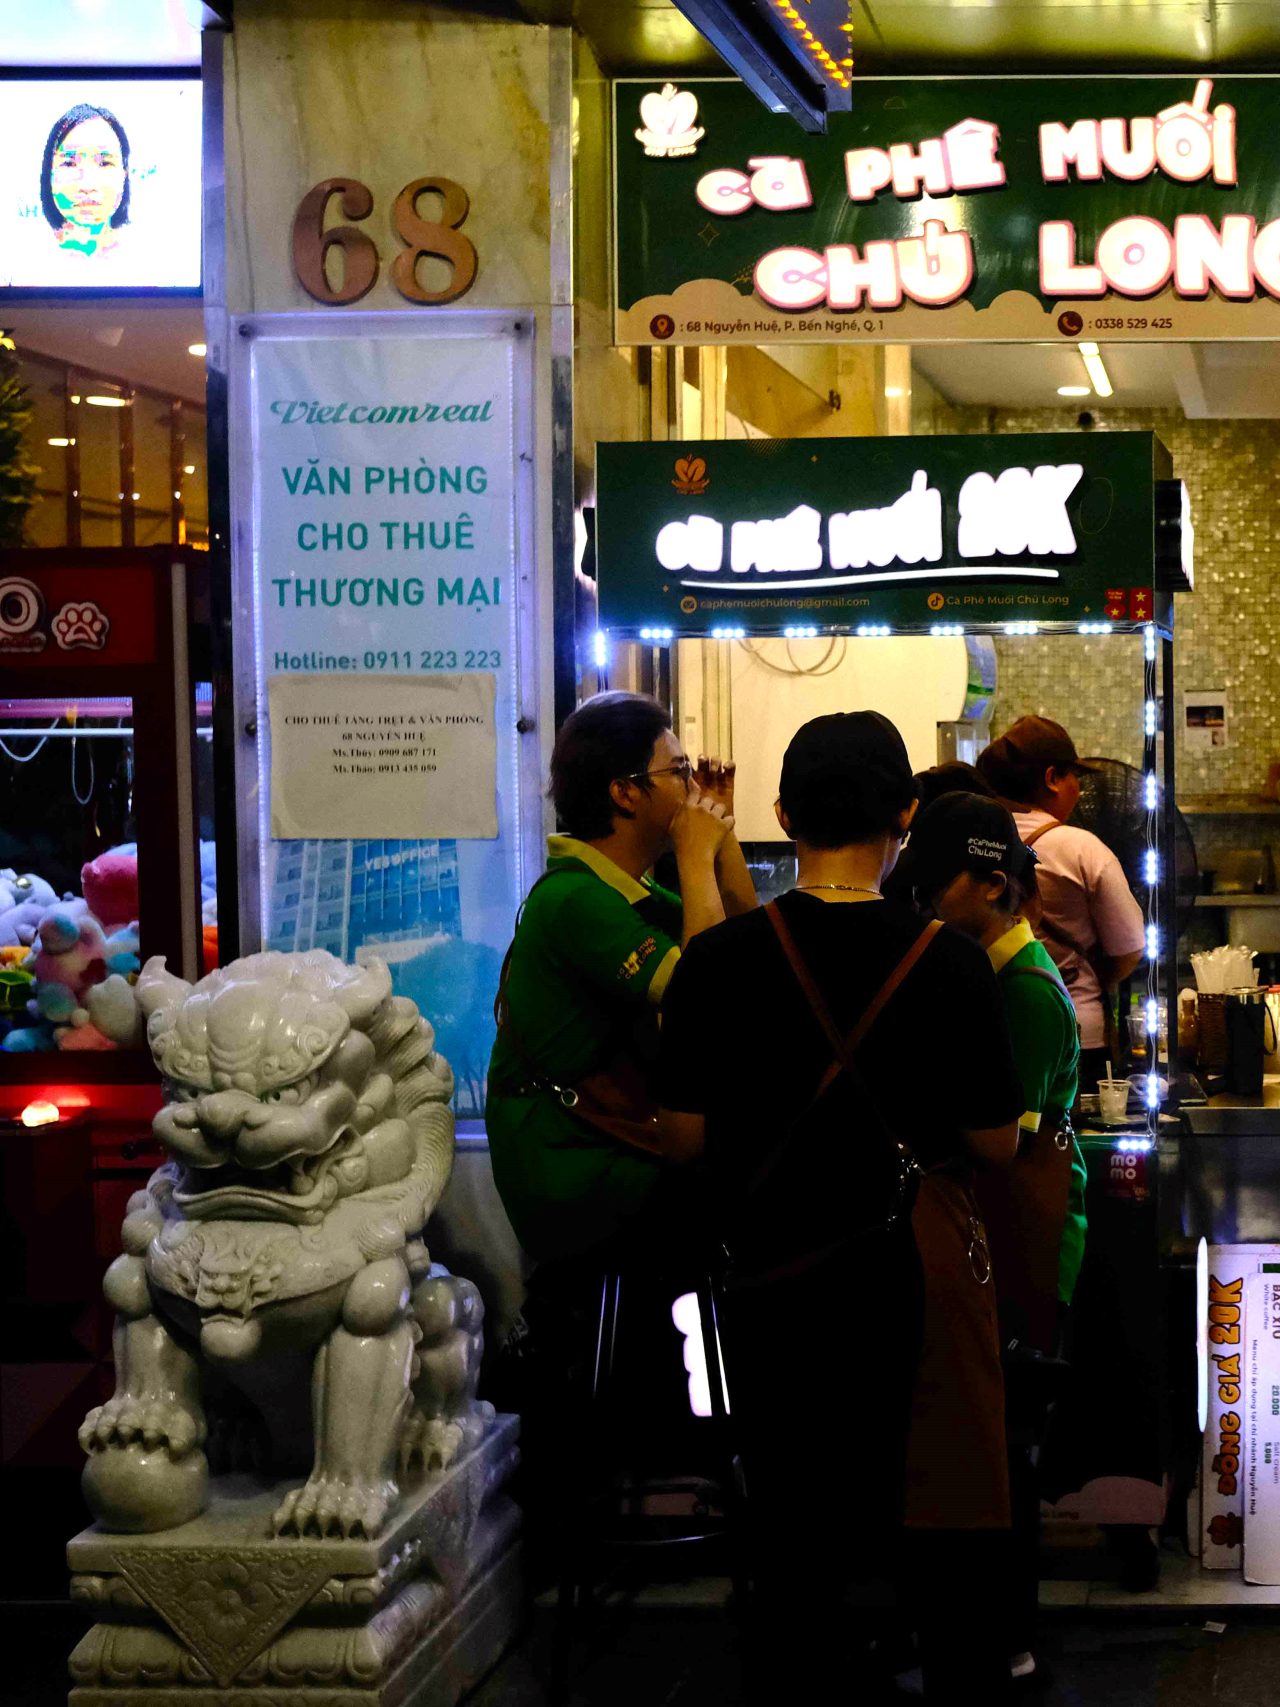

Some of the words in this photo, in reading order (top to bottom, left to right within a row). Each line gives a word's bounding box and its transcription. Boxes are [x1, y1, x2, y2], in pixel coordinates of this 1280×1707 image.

[845, 118, 1006, 200] PHÊ
[291, 176, 479, 305] 68
[686, 321, 701, 332] 68
[784, 321, 796, 332] P.
[879, 320, 884, 331] 1
[1095, 318, 1124, 329] 0338
[1126, 318, 1148, 329] 529
[1151, 318, 1173, 329] 425
[270, 400, 495, 425] Vietcomreal
[282, 458, 350, 496] VĂN
[364, 457, 488, 495] PHÒNG
[297, 522, 369, 551] CHO
[379, 512, 475, 551] THUÊ
[271, 577, 425, 608] THƯƠNG
[437, 577, 501, 613] MẠI
[1042, 595, 1070, 606] Long
[274, 652, 357, 670] Hotline:
[363, 651, 412, 670] 0911
[420, 651, 458, 669] 223
[464, 650, 501, 668] 223
[285, 716, 309, 725] CHO
[1208, 1275, 1244, 1346] 20K
[1211, 1353, 1242, 1404] GIÁ
[1272, 1385, 1280, 1416] 20.000
